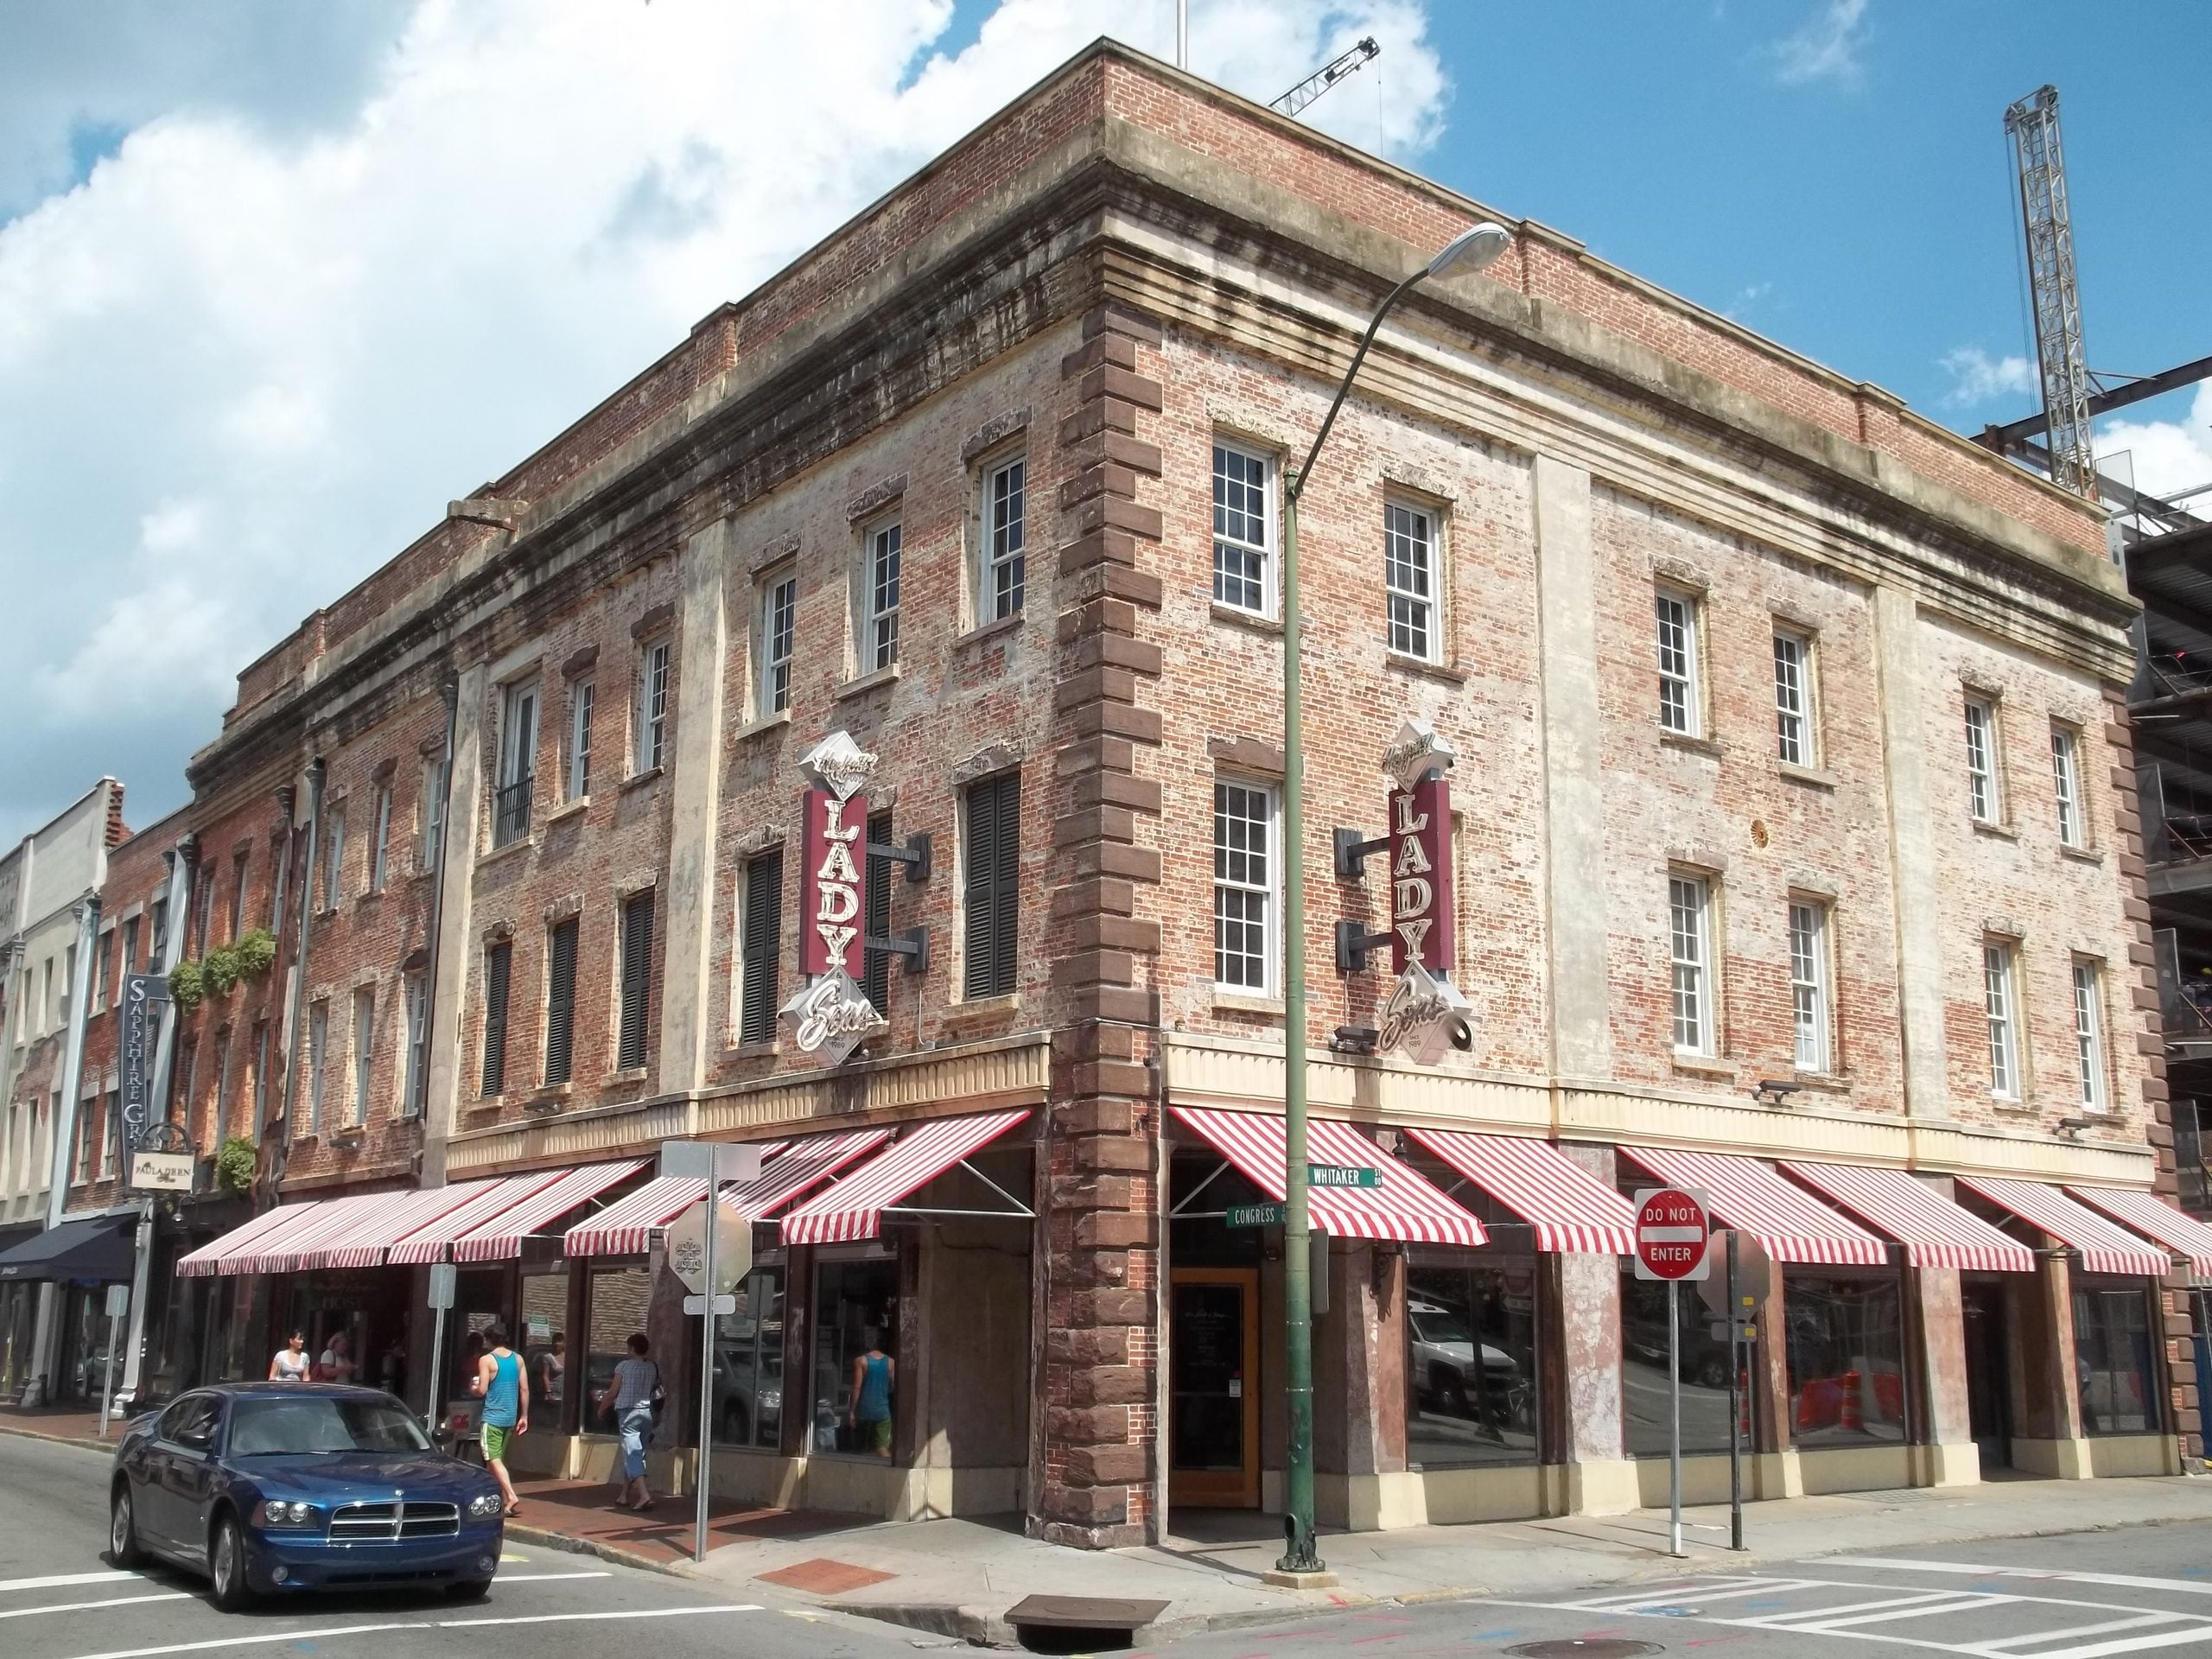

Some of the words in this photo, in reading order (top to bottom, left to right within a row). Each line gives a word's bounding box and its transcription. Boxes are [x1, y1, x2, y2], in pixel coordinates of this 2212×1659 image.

[817, 799, 860, 965] LADY
[1393, 794, 1432, 960] LADY
[797, 979, 885, 1052] Sons
[127, 980, 146, 1099] SAPPHIRE
[831, 1040, 846, 1050] 1989
[1408, 1039, 1421, 1048] 1989
[136, 1166, 162, 1176] PAULA
[164, 1166, 191, 1177] DEEN
[1313, 1168, 1359, 1185] WHITAKER
[1235, 1207, 1274, 1224] CONGRESS
[1646, 1208, 1663, 1222] DO
[1669, 1207, 1696, 1221] NOT
[1650, 1247, 1692, 1261] ENTER
